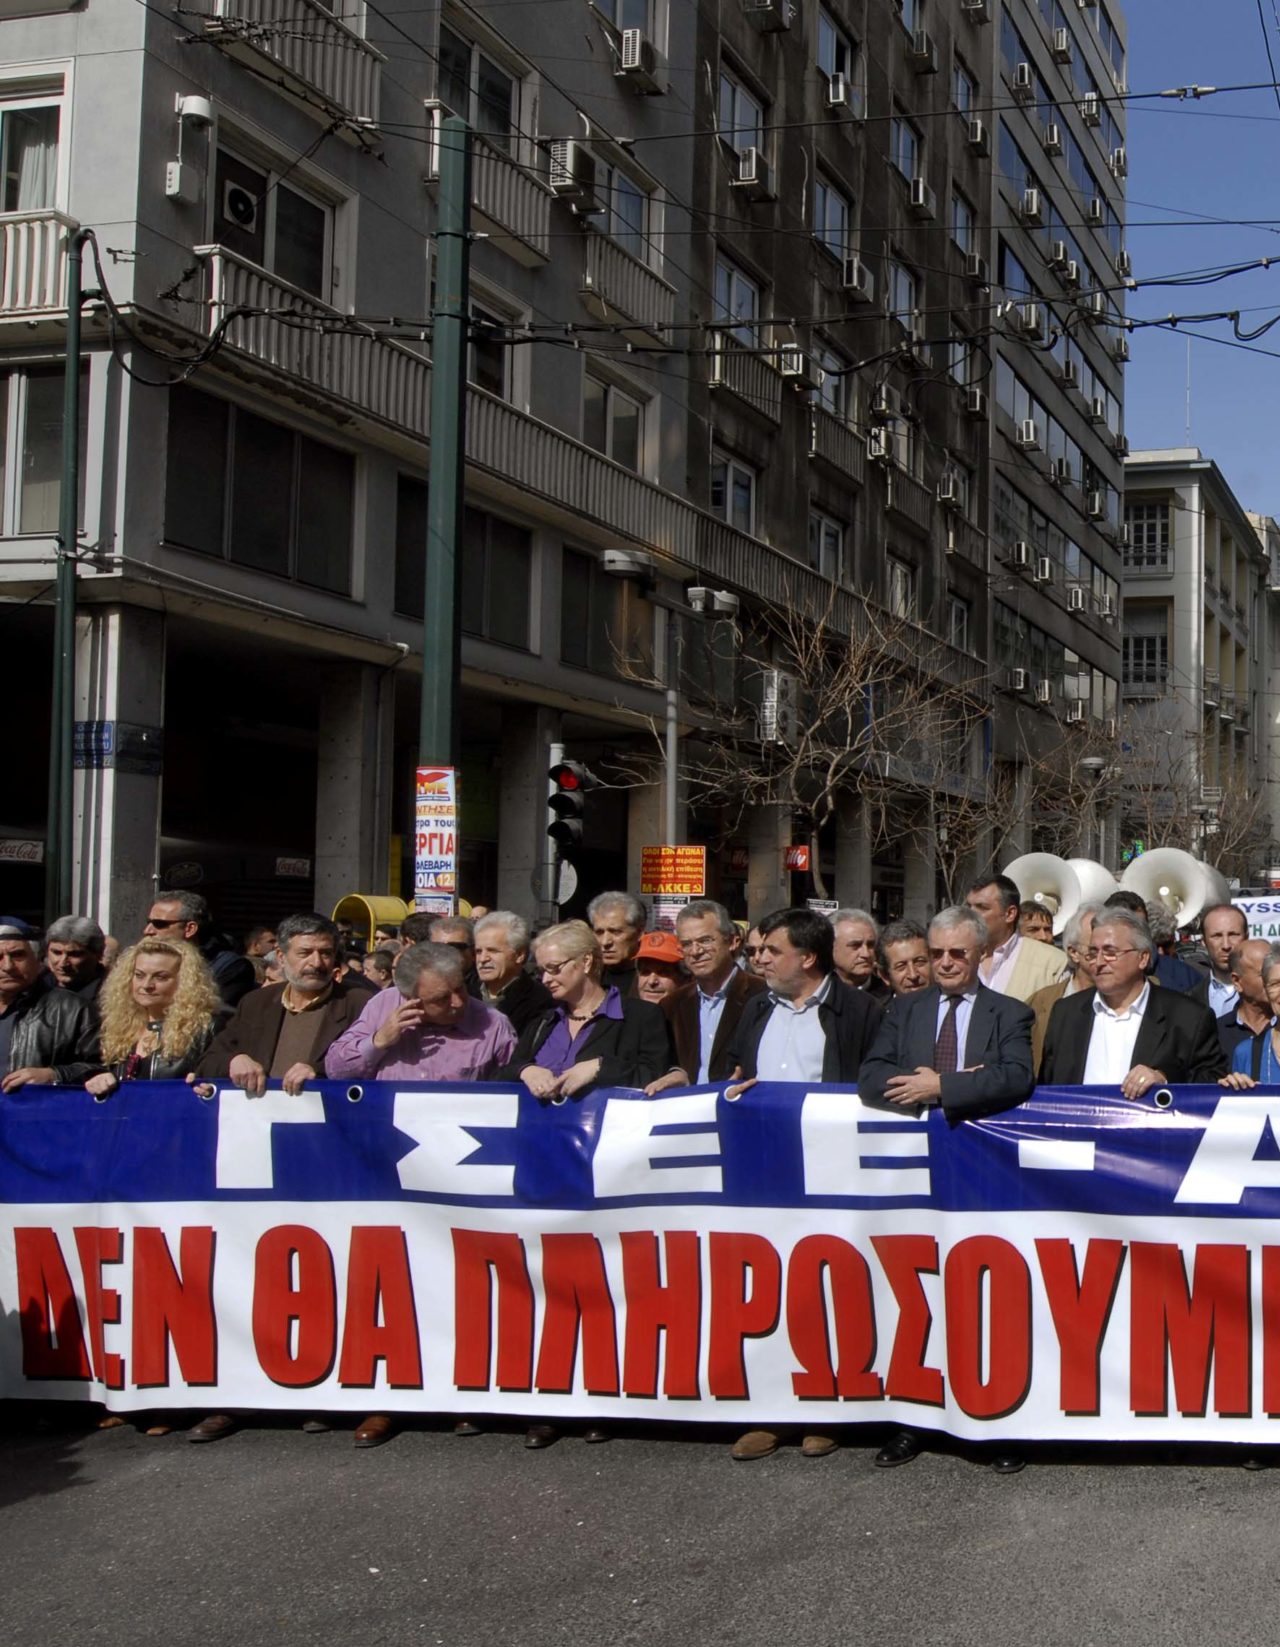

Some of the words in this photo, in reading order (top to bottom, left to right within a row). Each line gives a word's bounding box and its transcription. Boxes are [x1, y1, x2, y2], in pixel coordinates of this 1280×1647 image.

[787, 850, 807, 867] illy
[14, 1226, 218, 1390] ΔΕΝ
[252, 1224, 423, 1390] ΘΑ
